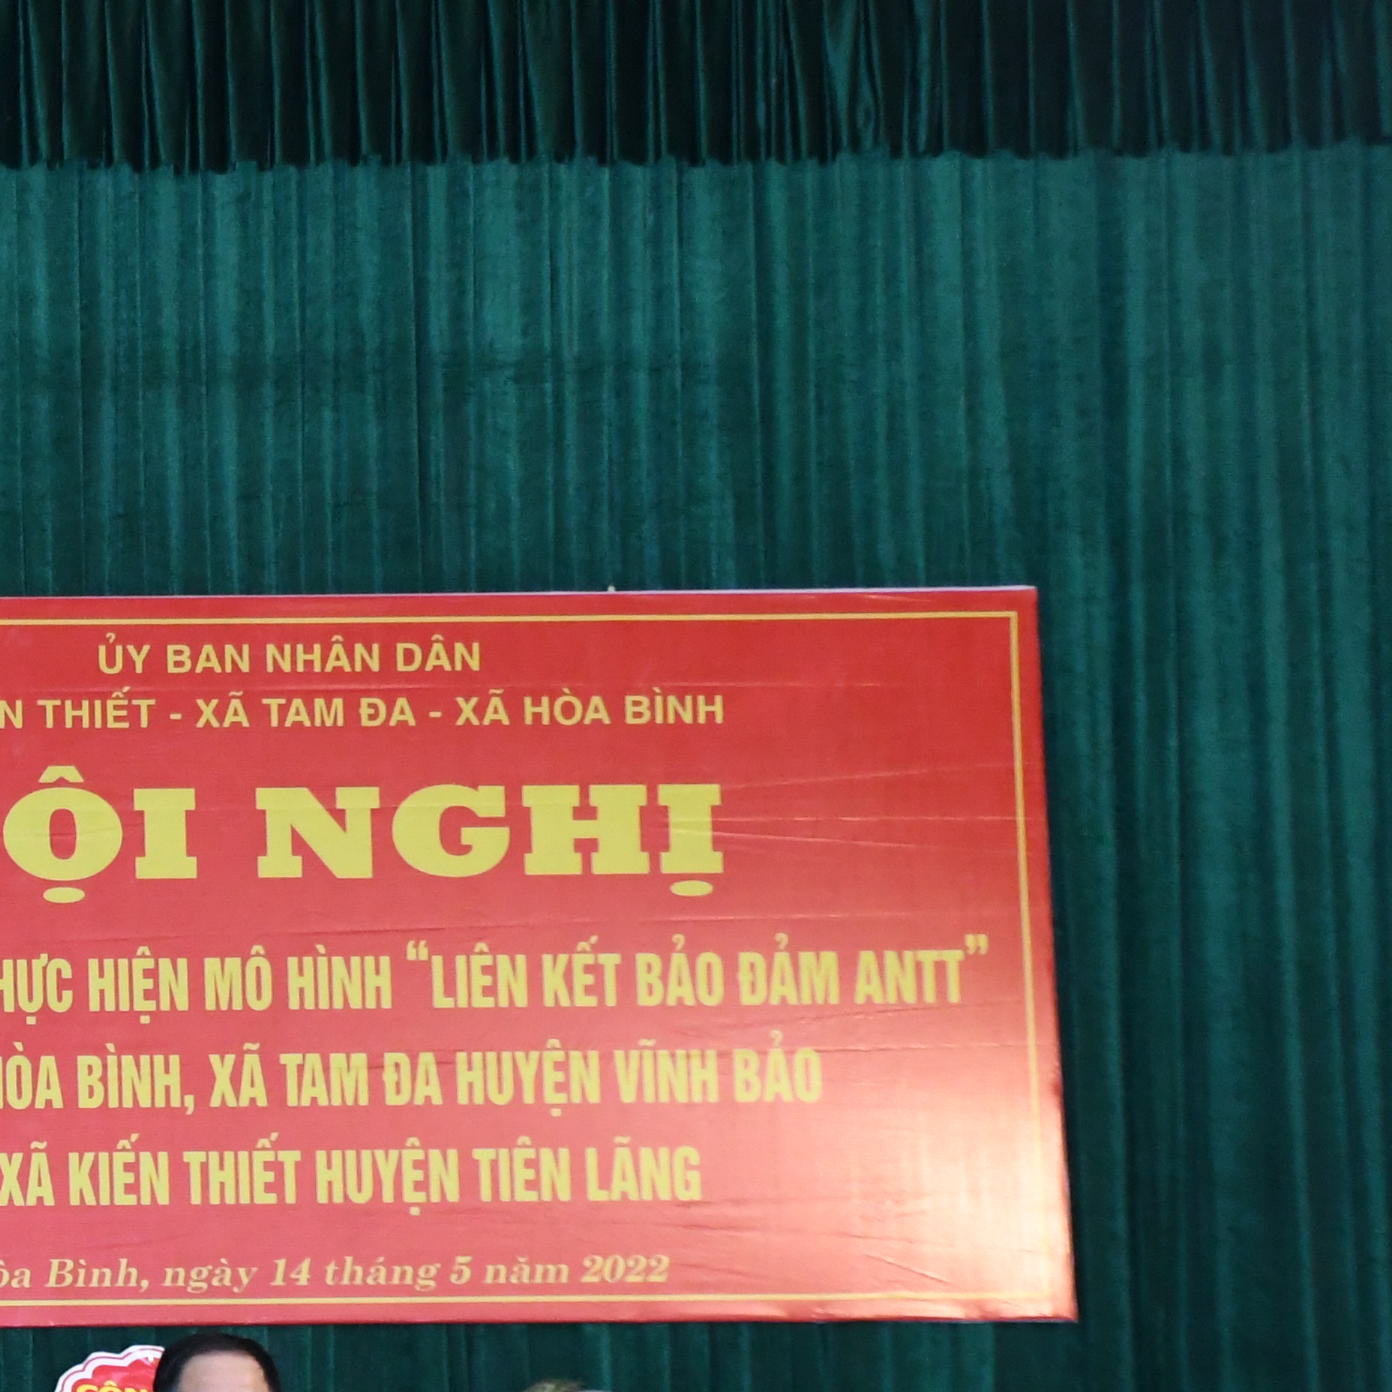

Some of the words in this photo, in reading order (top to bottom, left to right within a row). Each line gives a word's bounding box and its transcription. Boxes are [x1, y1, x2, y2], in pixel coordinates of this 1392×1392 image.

[98, 632, 150, 674] ỦY
[166, 643, 250, 673] BAN
[266, 634, 380, 673] NHÂN
[396, 634, 480, 671] DÂN
[38, 687, 156, 728] THIẾT
[196, 691, 250, 728] XÃ
[262, 697, 344, 727] TAM
[359, 697, 416, 726] ĐA
[455, 689, 510, 726] XÃ
[524, 688, 611, 725] HÒA
[624, 687, 724, 725] BÌNH
[255, 783, 724, 897] NGHỊ
[88, 946, 189, 1024] HIỆN
[204, 945, 273, 1012] MÔ
[287, 944, 393, 1010] HÌNH
[406, 940, 529, 1009] “LIÊN
[542, 935, 622, 1008] KẾT
[636, 933, 724, 1007] BẢO
[738, 932, 840, 1005] ĐẢM
[854, 933, 989, 1004] ANTT”
[76, 1043, 195, 1115] BÌNH,
[208, 1043, 268, 1107] XÃ
[279, 1052, 369, 1106] TAM
[382, 1052, 443, 1105] ĐA
[456, 1039, 601, 1117] HUYỆN
[614, 1036, 719, 1104] VĨNH
[733, 1029, 822, 1102] BẢO
[68, 1132, 169, 1206] KIẾN
[183, 1131, 302, 1204] THIẾT
[316, 1137, 459, 1216] HUYỆN
[472, 1135, 571, 1202] TIÊN
[585, 1134, 702, 1201] LÃNG
[45, 1257, 150, 1292] Bình,
[162, 1257, 258, 1294] ngày
[270, 1257, 312, 1287] 14
[324, 1256, 441, 1292] tháng
[449, 1255, 473, 1285] 5
[484, 1257, 570, 1284] năm
[580, 1253, 671, 1284] 2022
